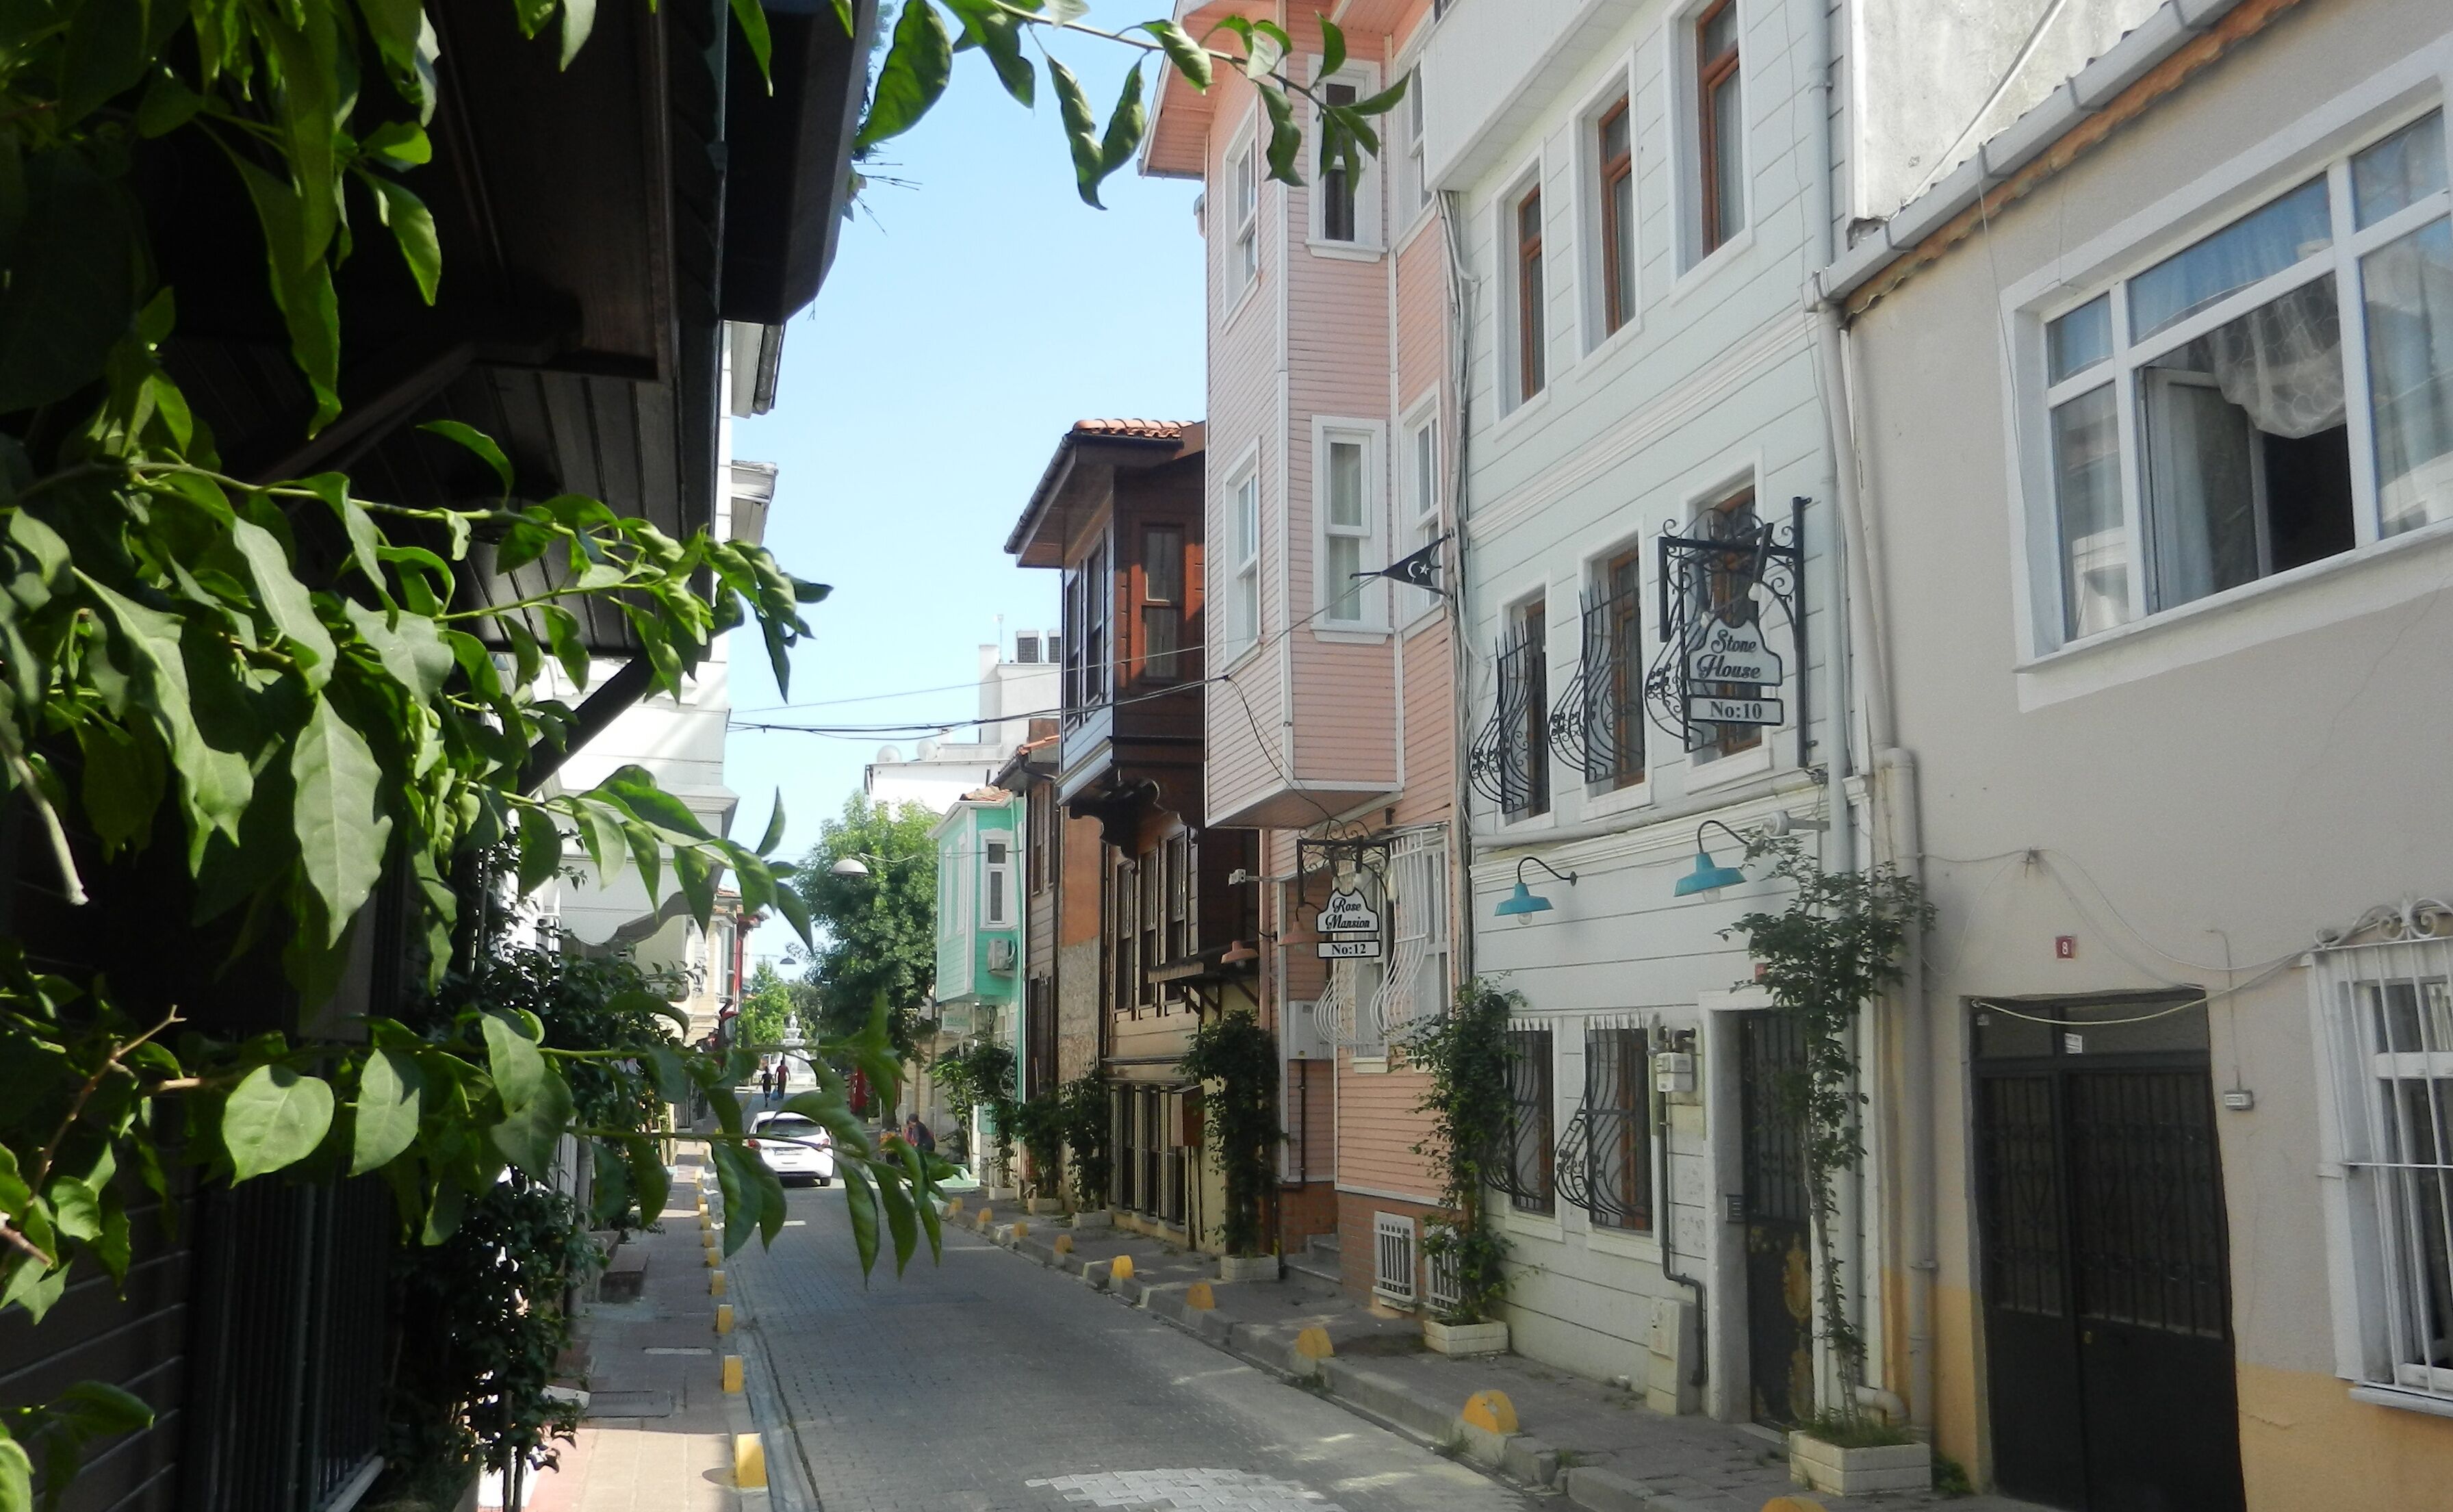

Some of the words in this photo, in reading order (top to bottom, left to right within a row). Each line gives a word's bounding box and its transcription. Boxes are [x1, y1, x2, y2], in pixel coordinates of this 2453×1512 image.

[1711, 629, 1756, 654] Stone
[1697, 654, 1761, 678] House
[1710, 700, 1762, 719] No:10
[1332, 897, 1361, 913] Rose
[1325, 914, 1370, 930] Mansion
[1331, 943, 1366, 955] No:12
[2062, 941, 2068, 955] 8
